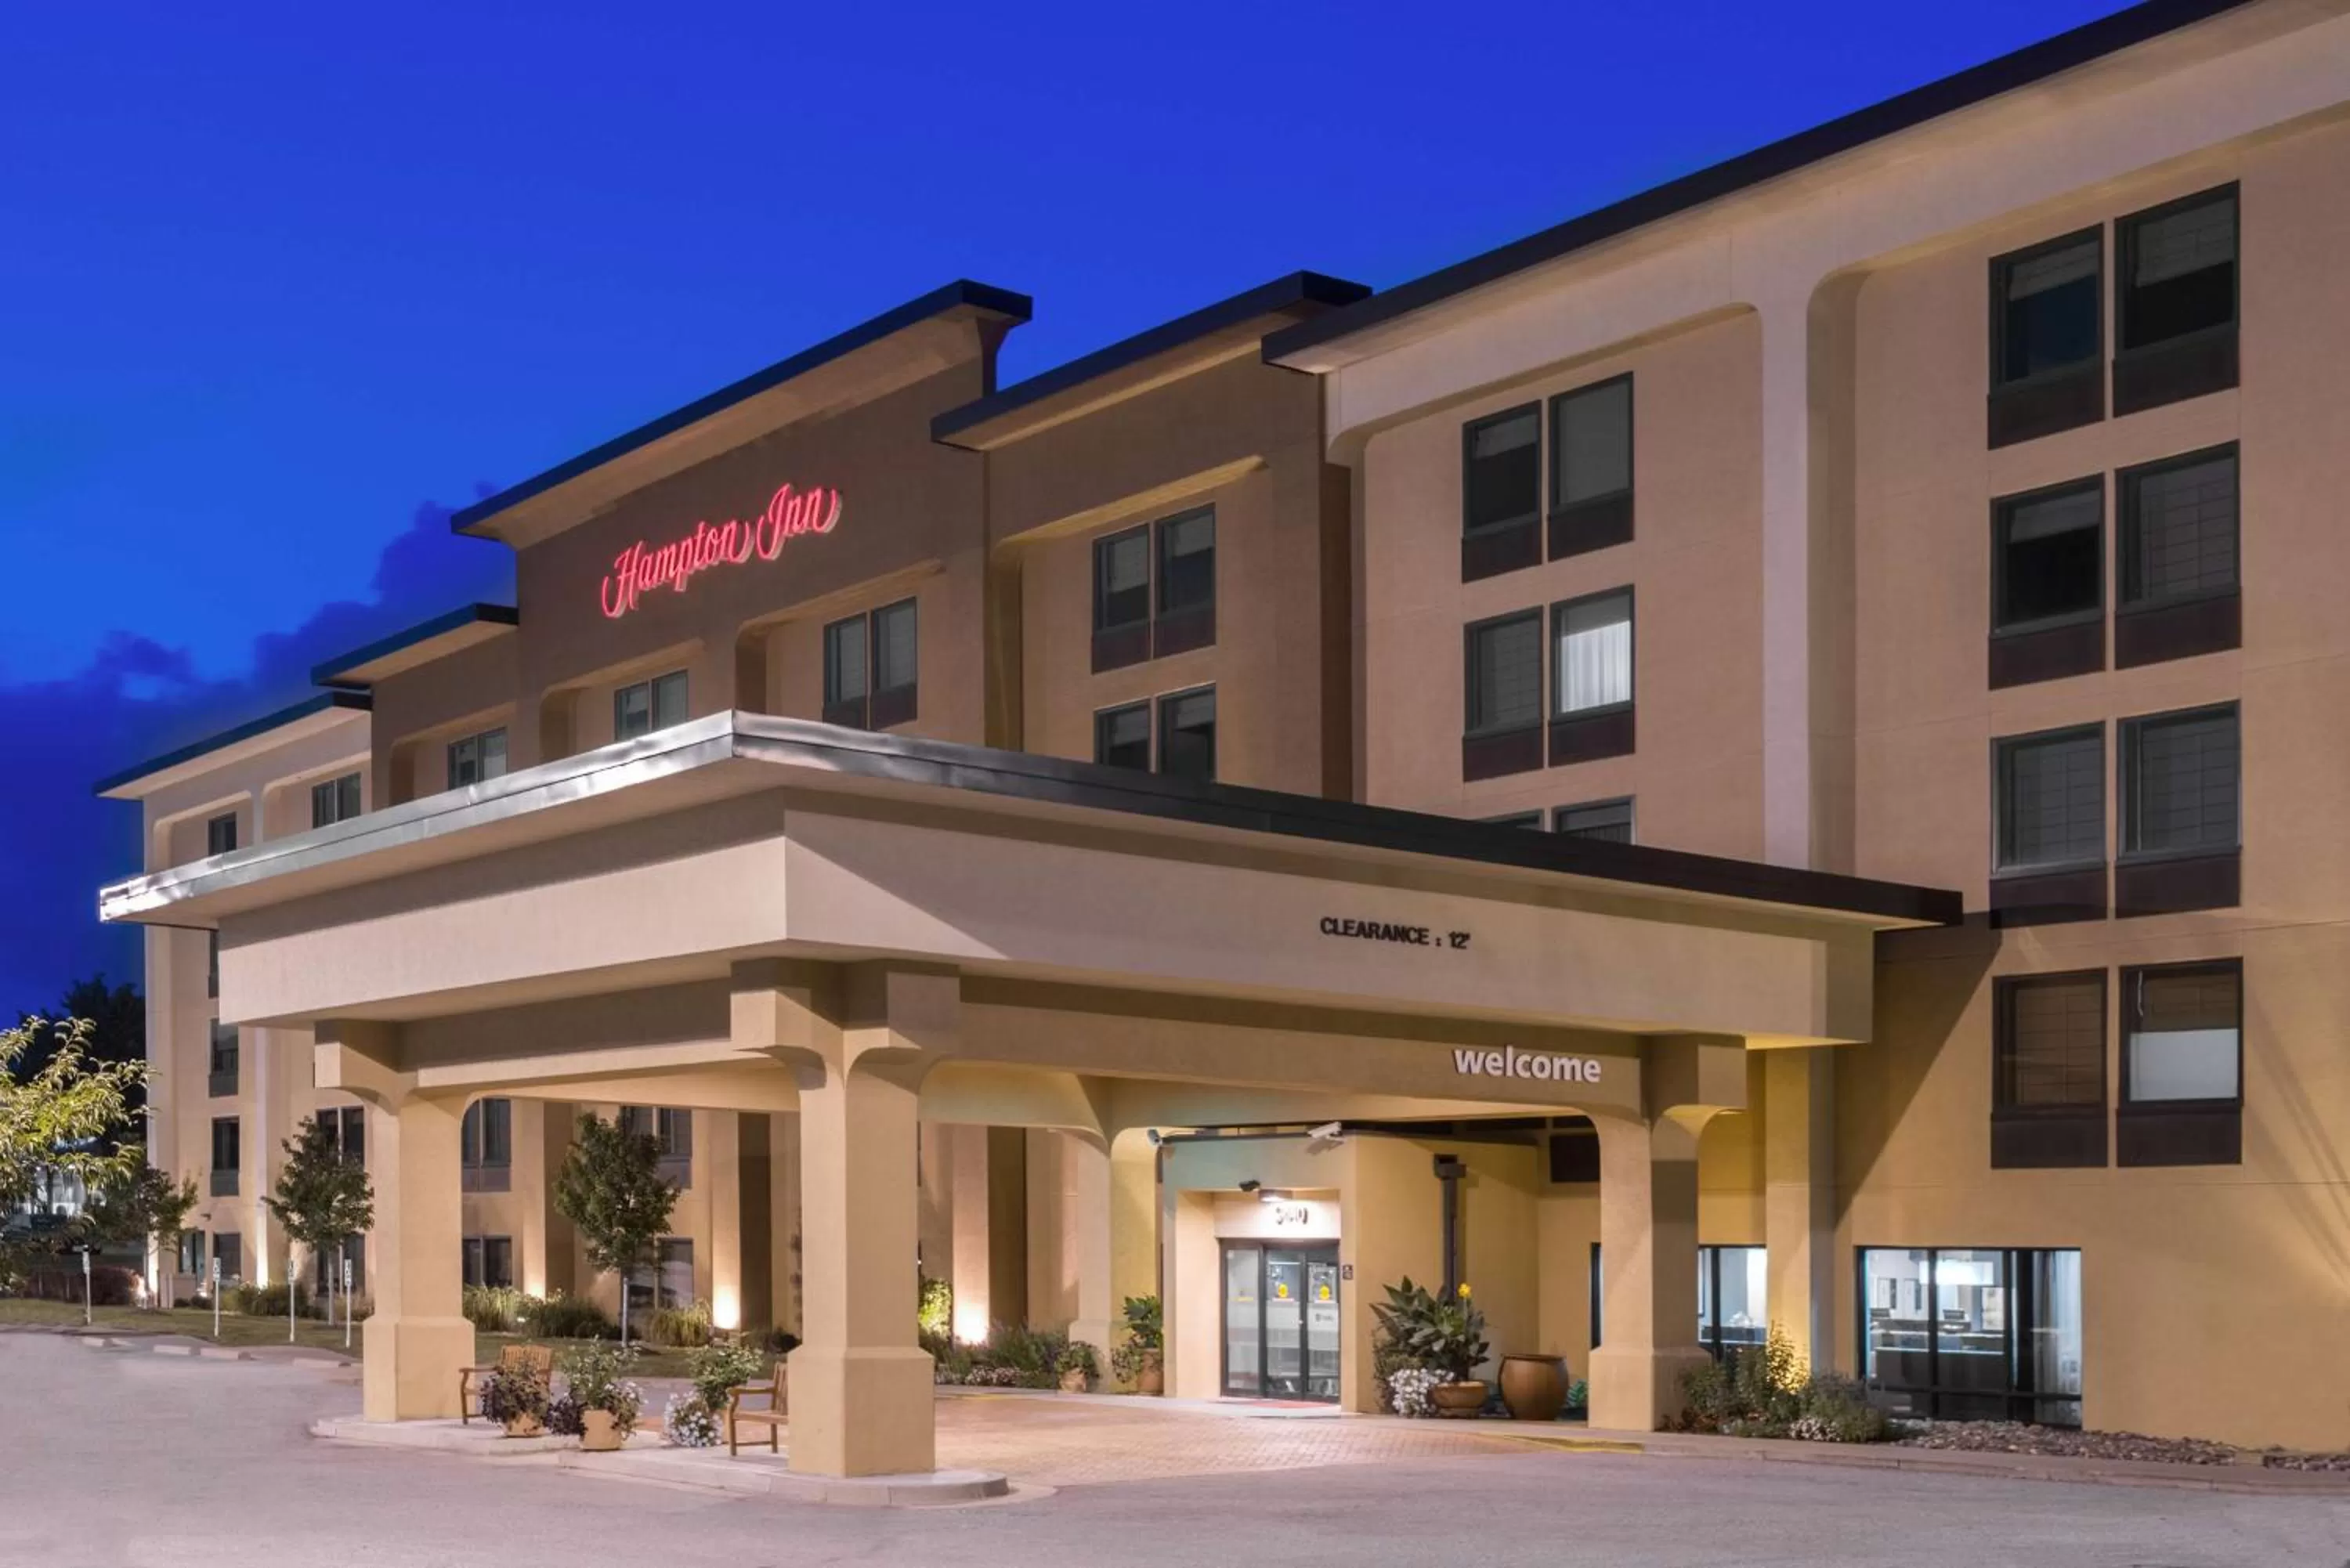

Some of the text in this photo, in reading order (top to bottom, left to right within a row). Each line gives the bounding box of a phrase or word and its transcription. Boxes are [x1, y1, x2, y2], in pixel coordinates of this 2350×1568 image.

[602, 482, 841, 618] Hampton Inn
[1320, 916, 1430, 945] CLEARANCE
[1454, 1045, 1602, 1082] welcome
